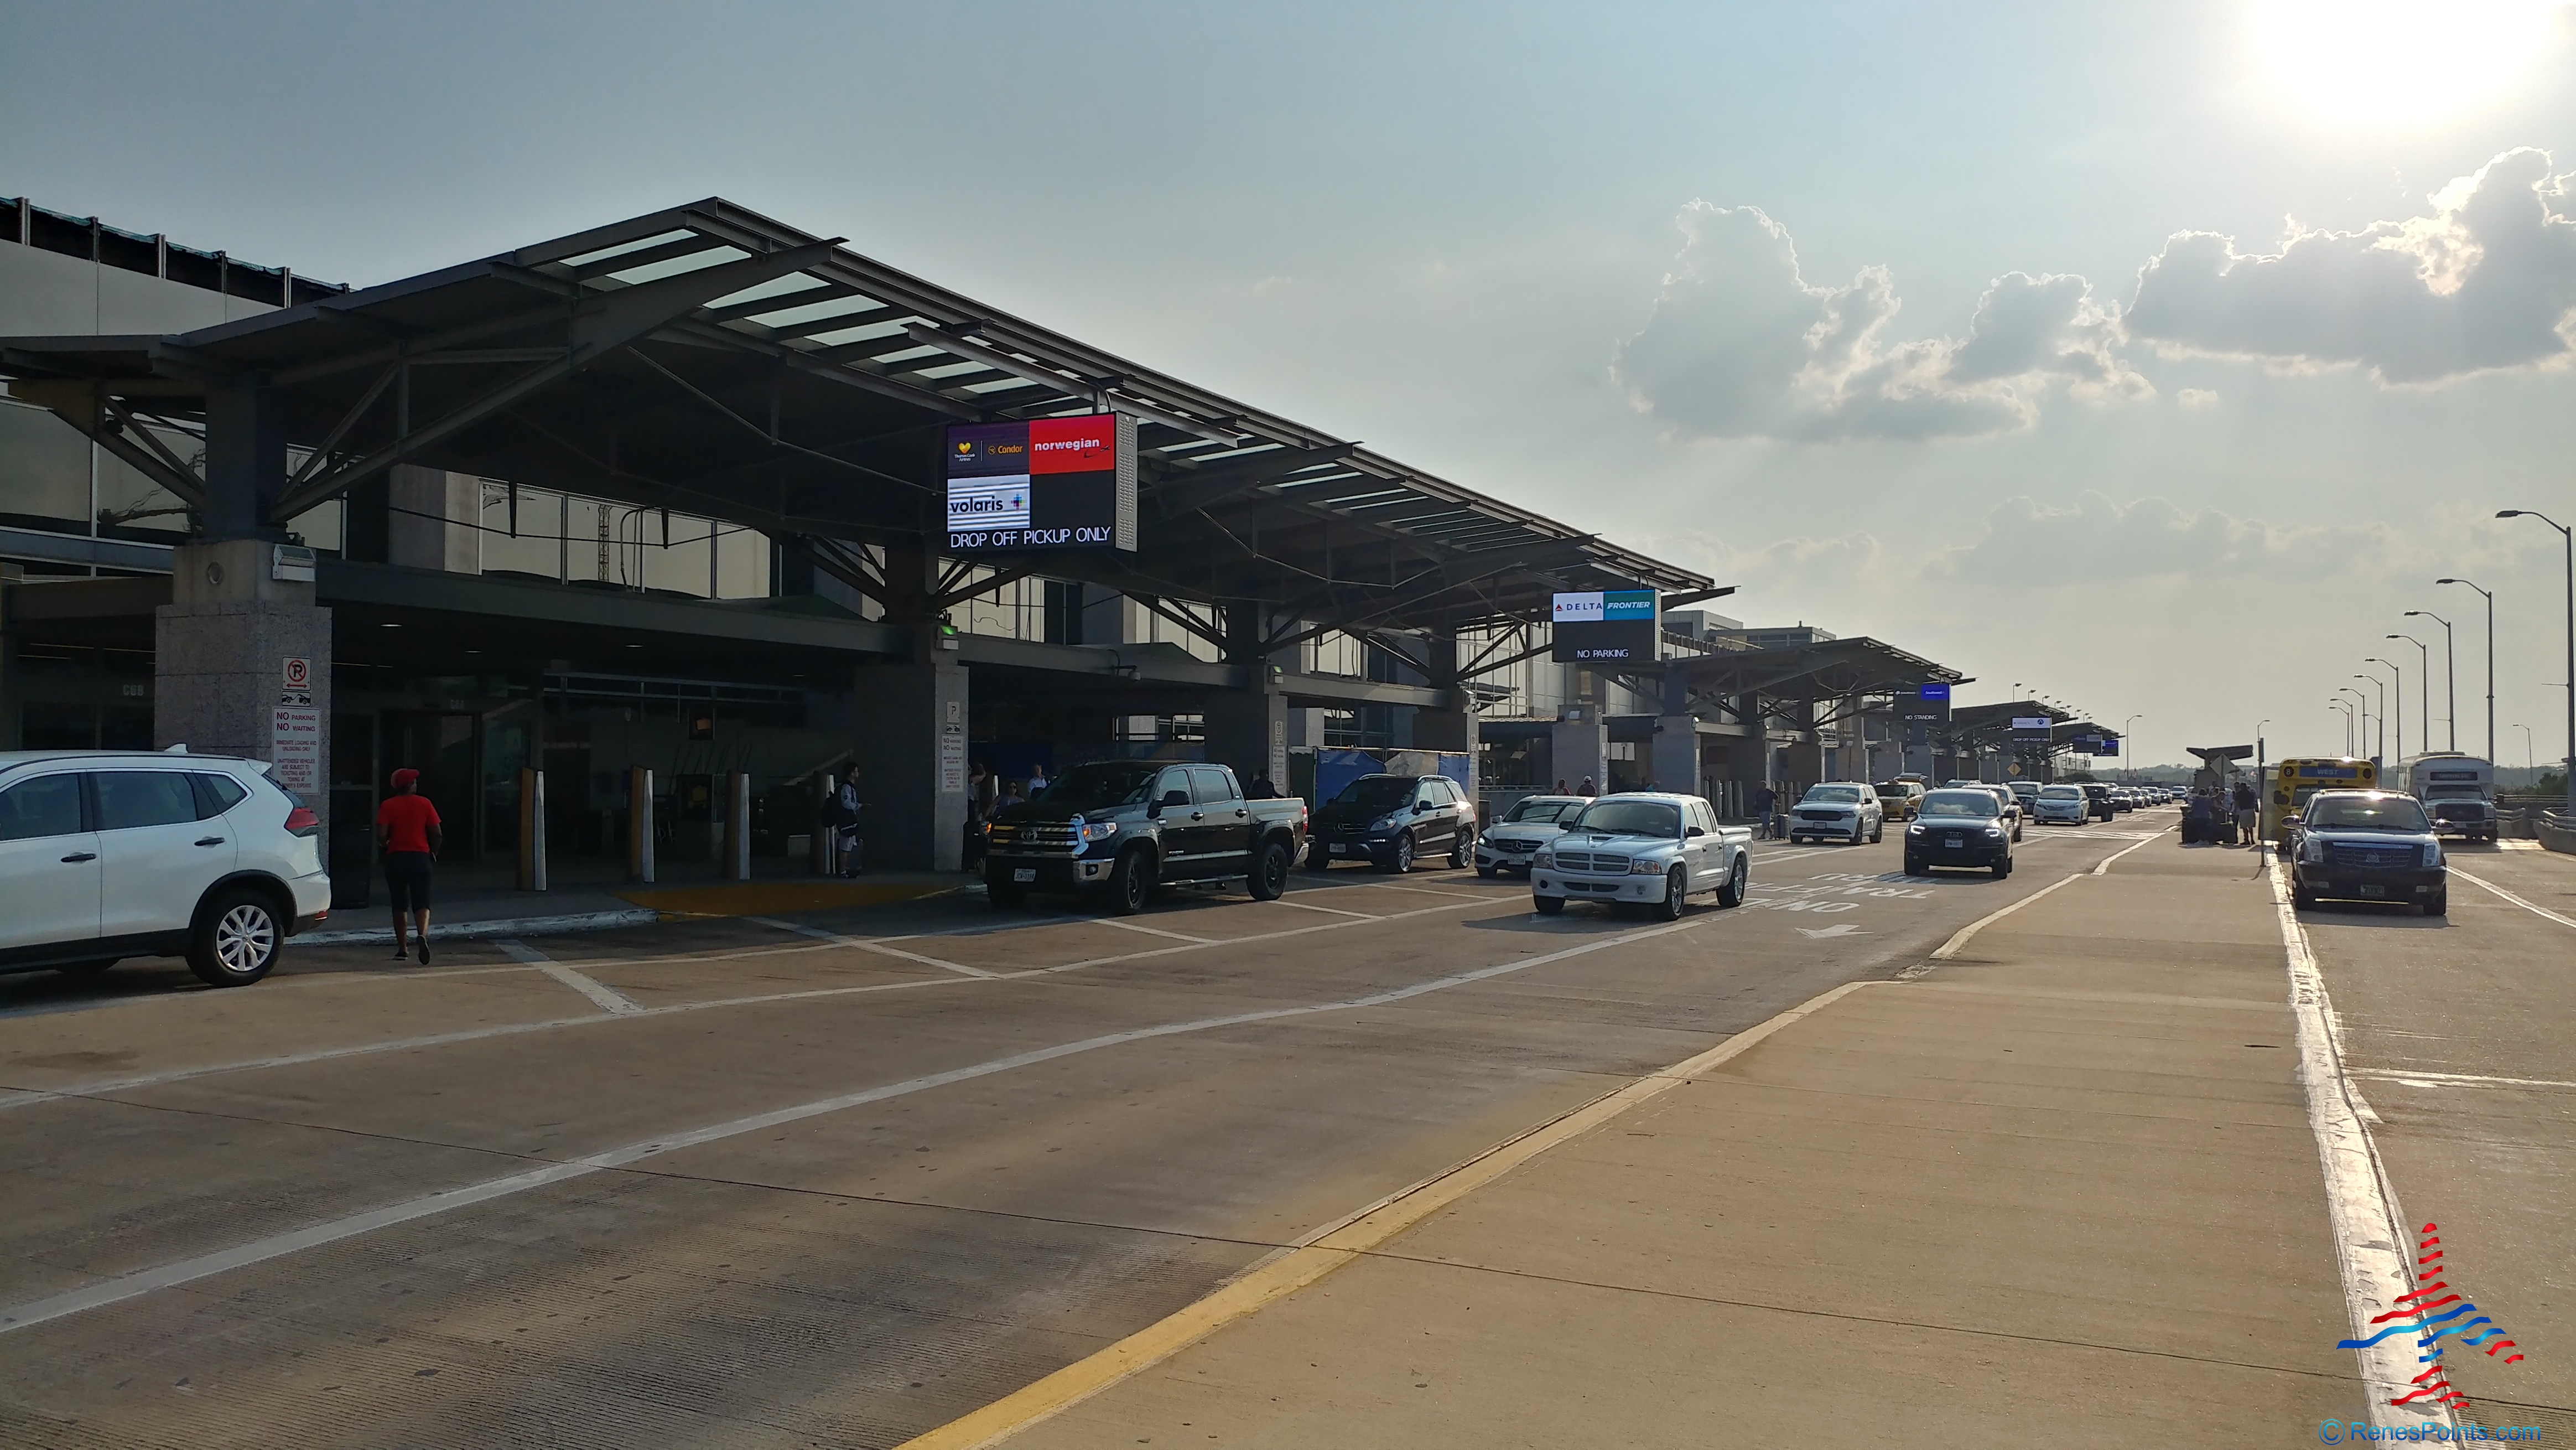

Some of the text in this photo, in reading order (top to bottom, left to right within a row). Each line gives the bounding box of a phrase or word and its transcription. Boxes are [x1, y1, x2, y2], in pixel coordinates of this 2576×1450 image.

[998, 444, 1023, 454] Condor
[1035, 438, 1100, 451] norwegian
[951, 496, 1003, 512] volaris
[951, 526, 1112, 548] DROP OFF PICKUP ONLY
[1607, 601, 1650, 609] FRONTIER
[1577, 649, 1629, 658] NO PARKING
[277, 712, 289, 720] NO
[277, 723, 289, 731] NO
